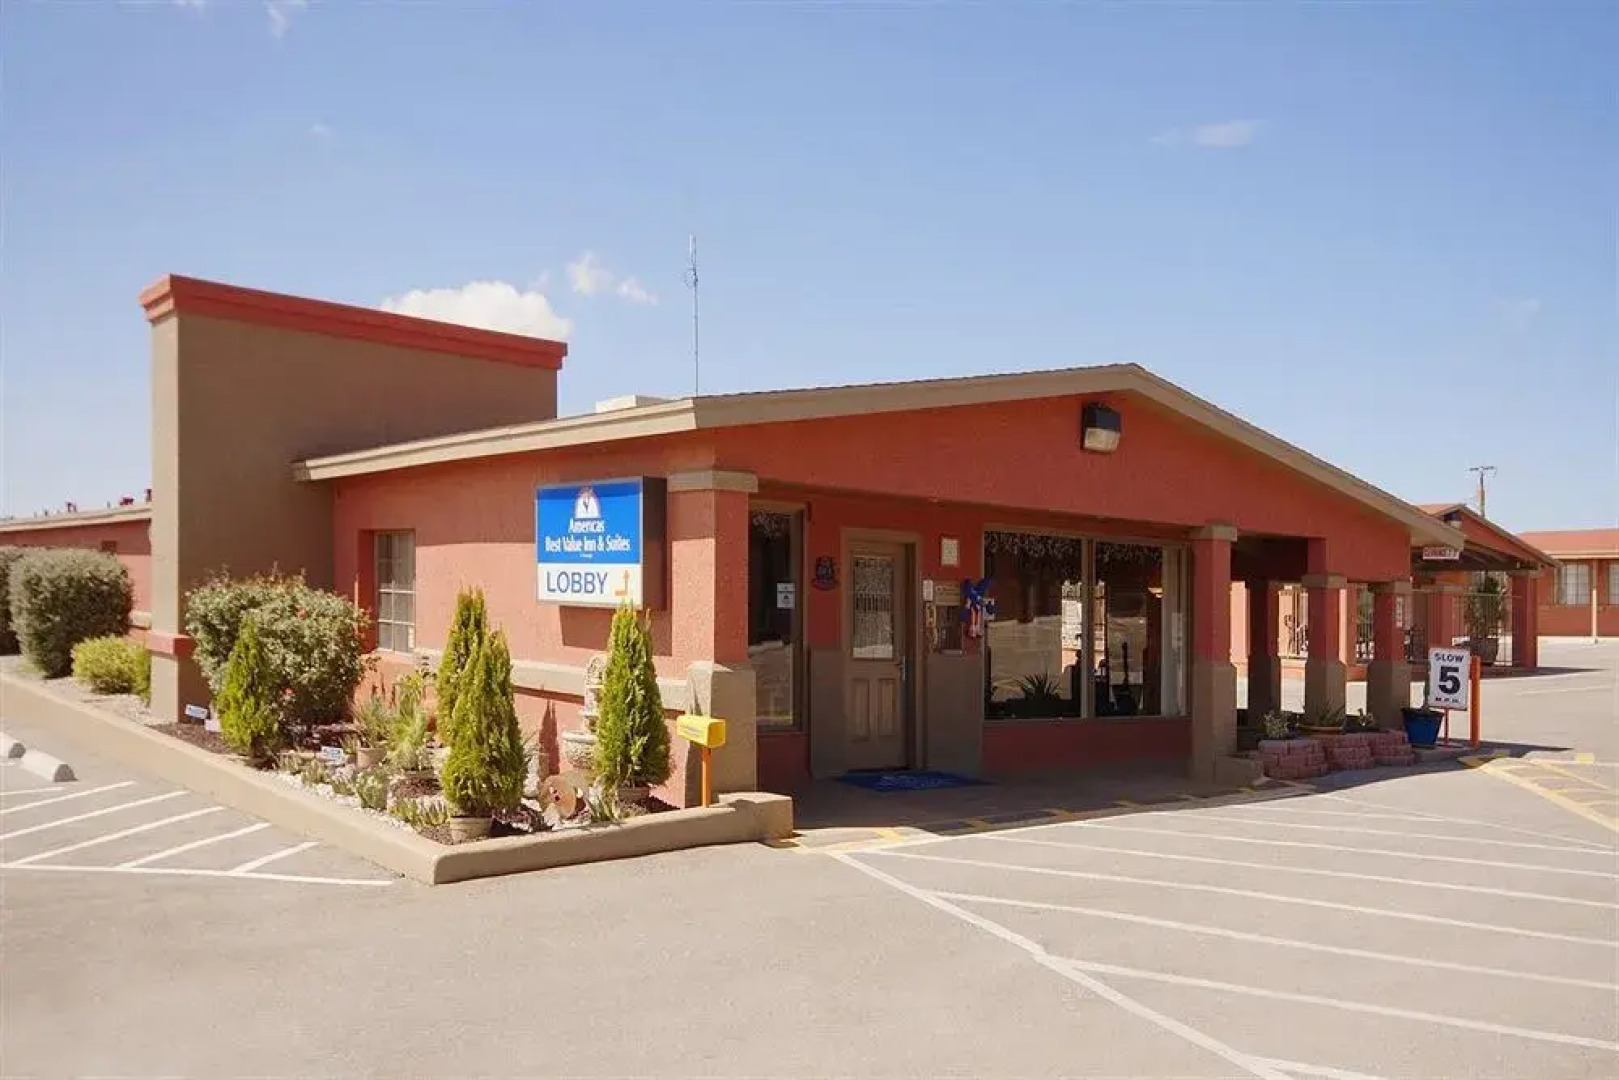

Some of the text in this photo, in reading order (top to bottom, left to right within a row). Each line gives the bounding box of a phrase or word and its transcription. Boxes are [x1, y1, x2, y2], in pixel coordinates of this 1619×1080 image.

[545, 534, 631, 552] Best Value Inn & Suites
[546, 571, 608, 594] LOBBY
[1434, 652, 1464, 662] SLOW
[1438, 666, 1460, 694] 5
